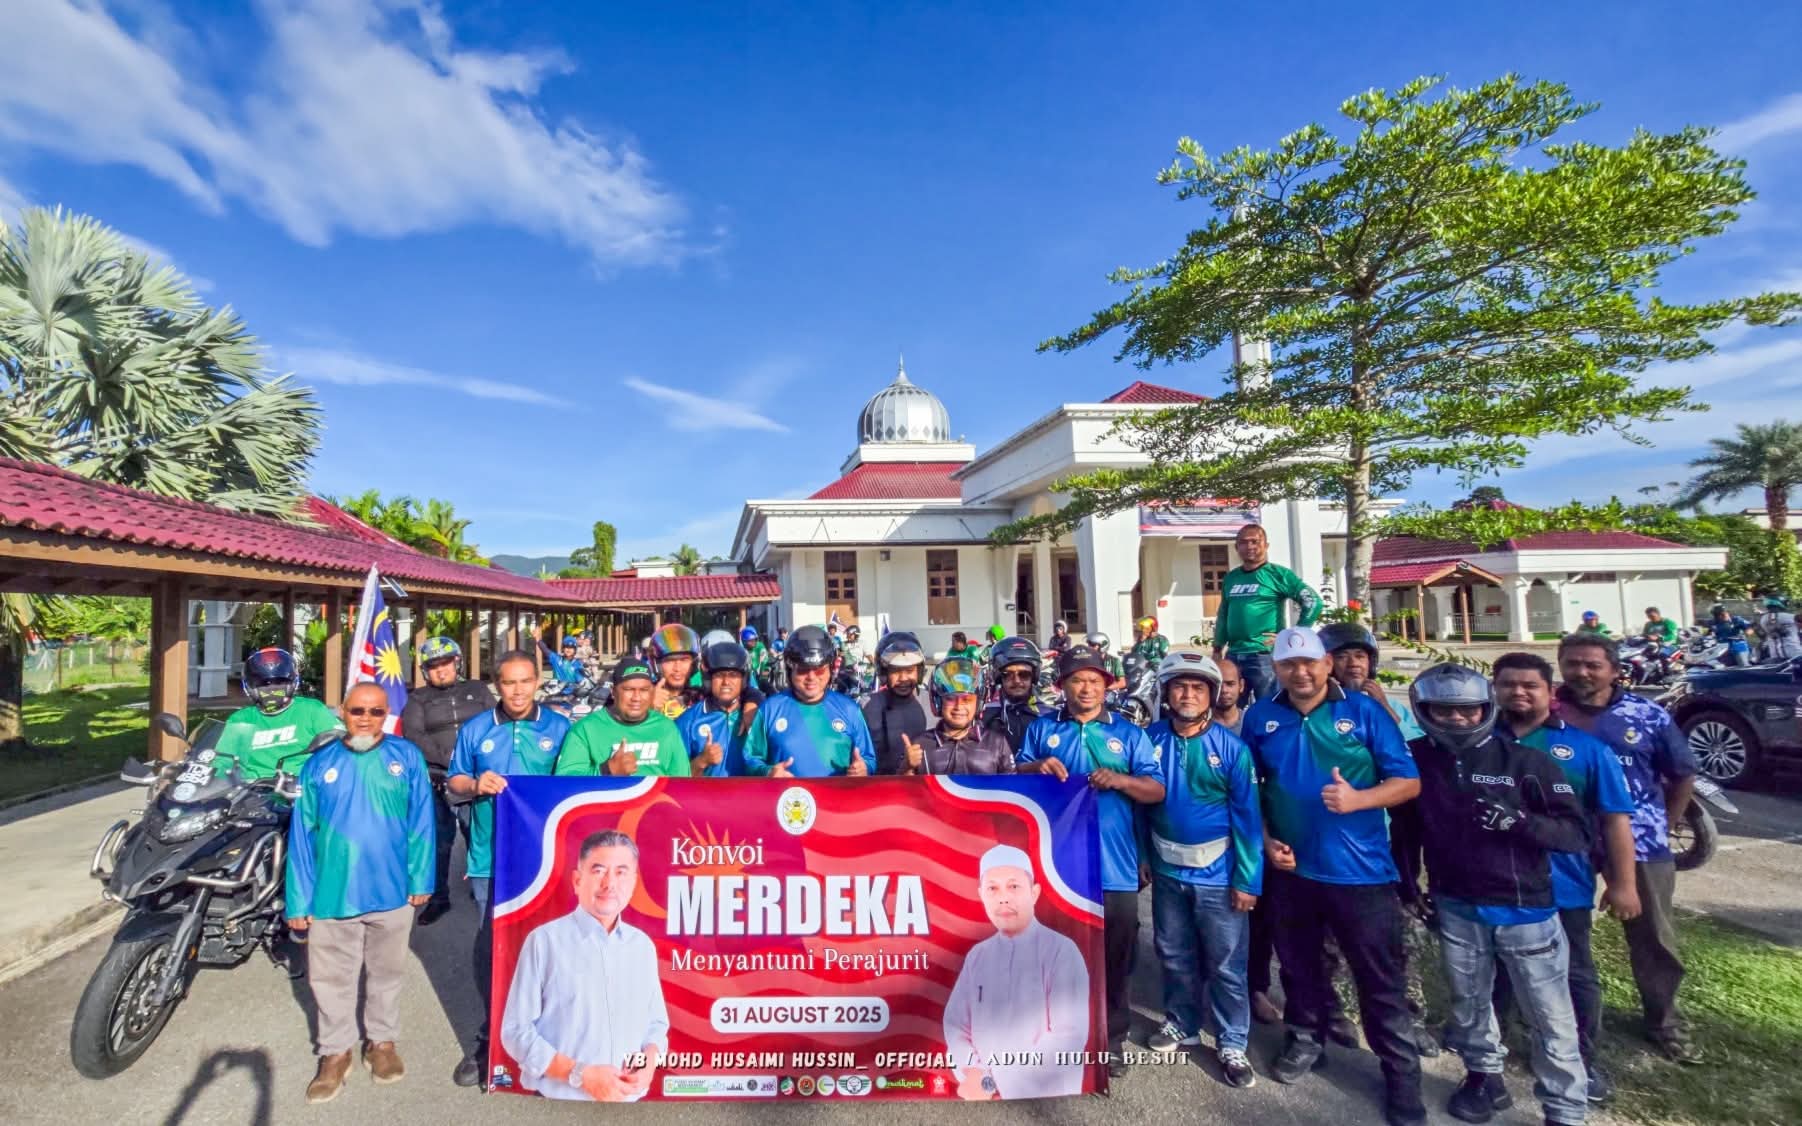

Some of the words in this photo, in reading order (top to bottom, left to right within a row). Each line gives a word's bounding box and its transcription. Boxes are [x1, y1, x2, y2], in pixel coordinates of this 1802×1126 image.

[671, 837, 765, 865] Konvoi
[666, 874, 930, 936] MERDEKA
[671, 948, 814, 976] Menyantuni
[823, 948, 930, 976] Perajurit
[720, 1006, 738, 1024] 31
[744, 1006, 829, 1024] AUGUST
[834, 1006, 882, 1024] 2025
